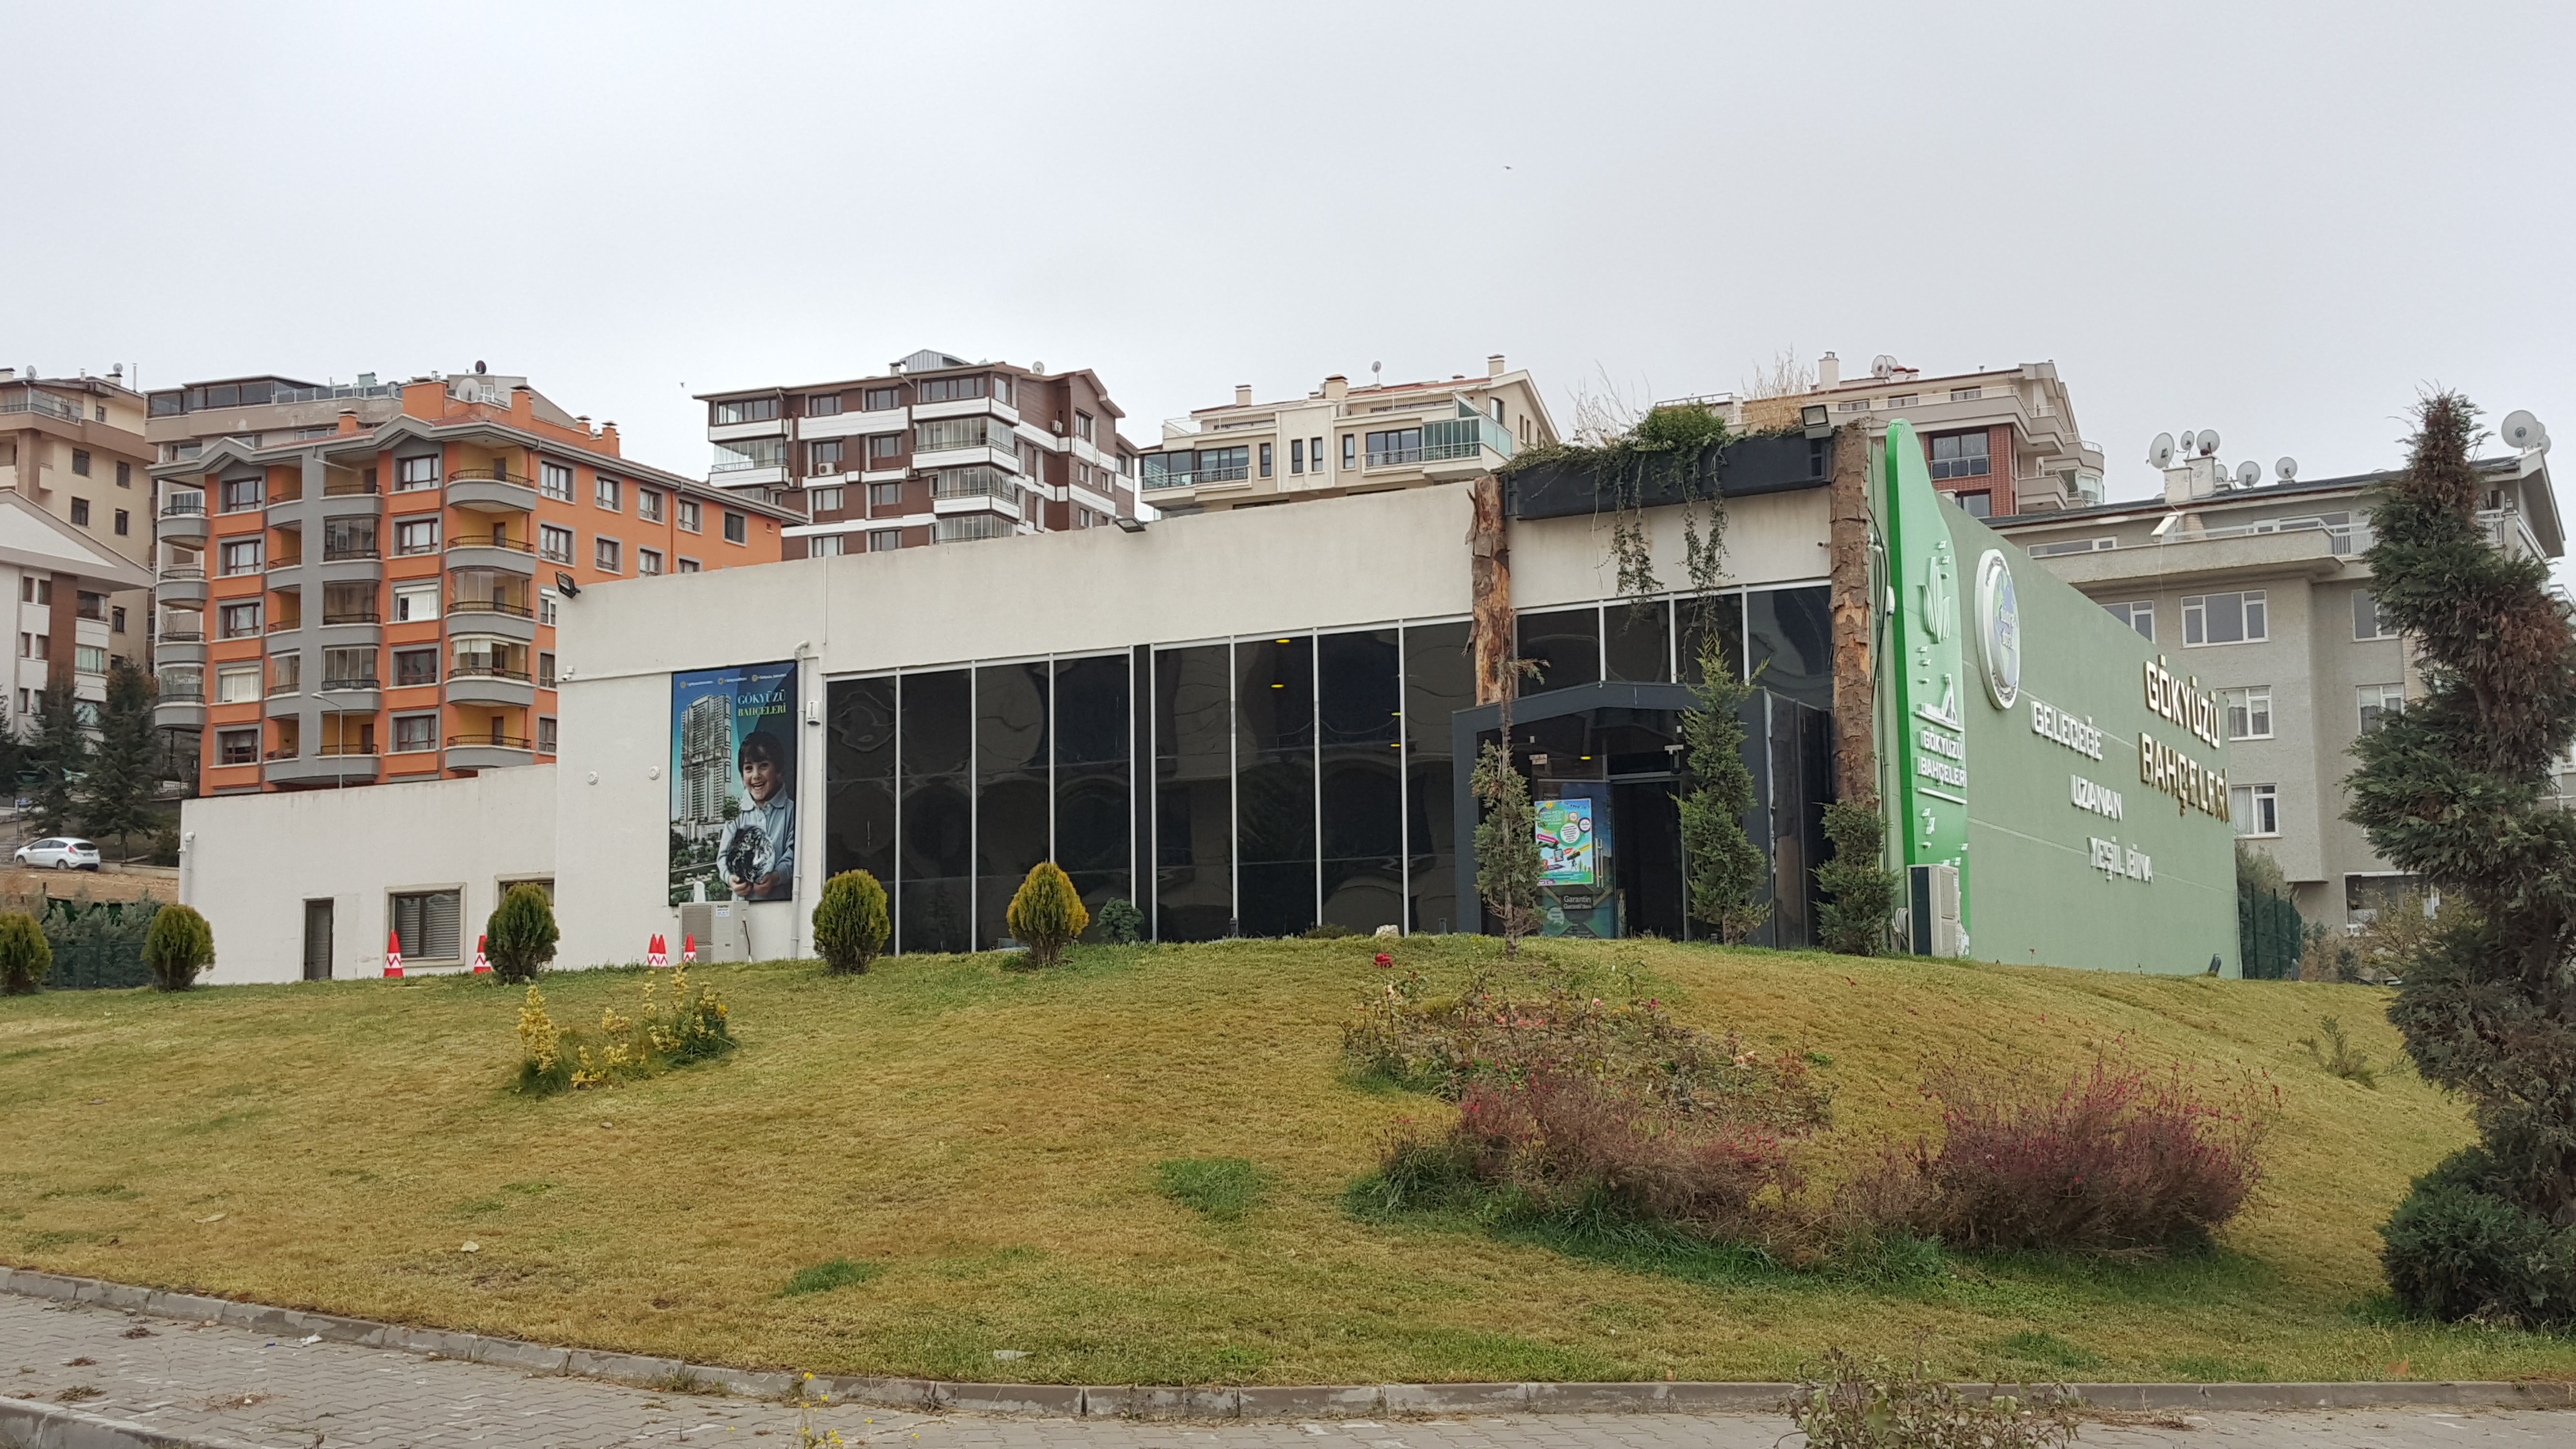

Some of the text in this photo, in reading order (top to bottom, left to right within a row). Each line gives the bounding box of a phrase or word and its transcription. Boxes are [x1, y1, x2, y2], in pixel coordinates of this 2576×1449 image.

[737, 689, 787, 705] GÖKYÜZÜ
[738, 703, 787, 717] BAHÇELERİ
[2143, 654, 2220, 749] GÖKYÜZÜ
[1920, 726, 1963, 760] GÖKYÜZÜ
[2030, 701, 2103, 760] GELECEĞE
[2070, 774, 2123, 821] UZANAN
[2087, 836, 2153, 883] YEŞİL BİNA
